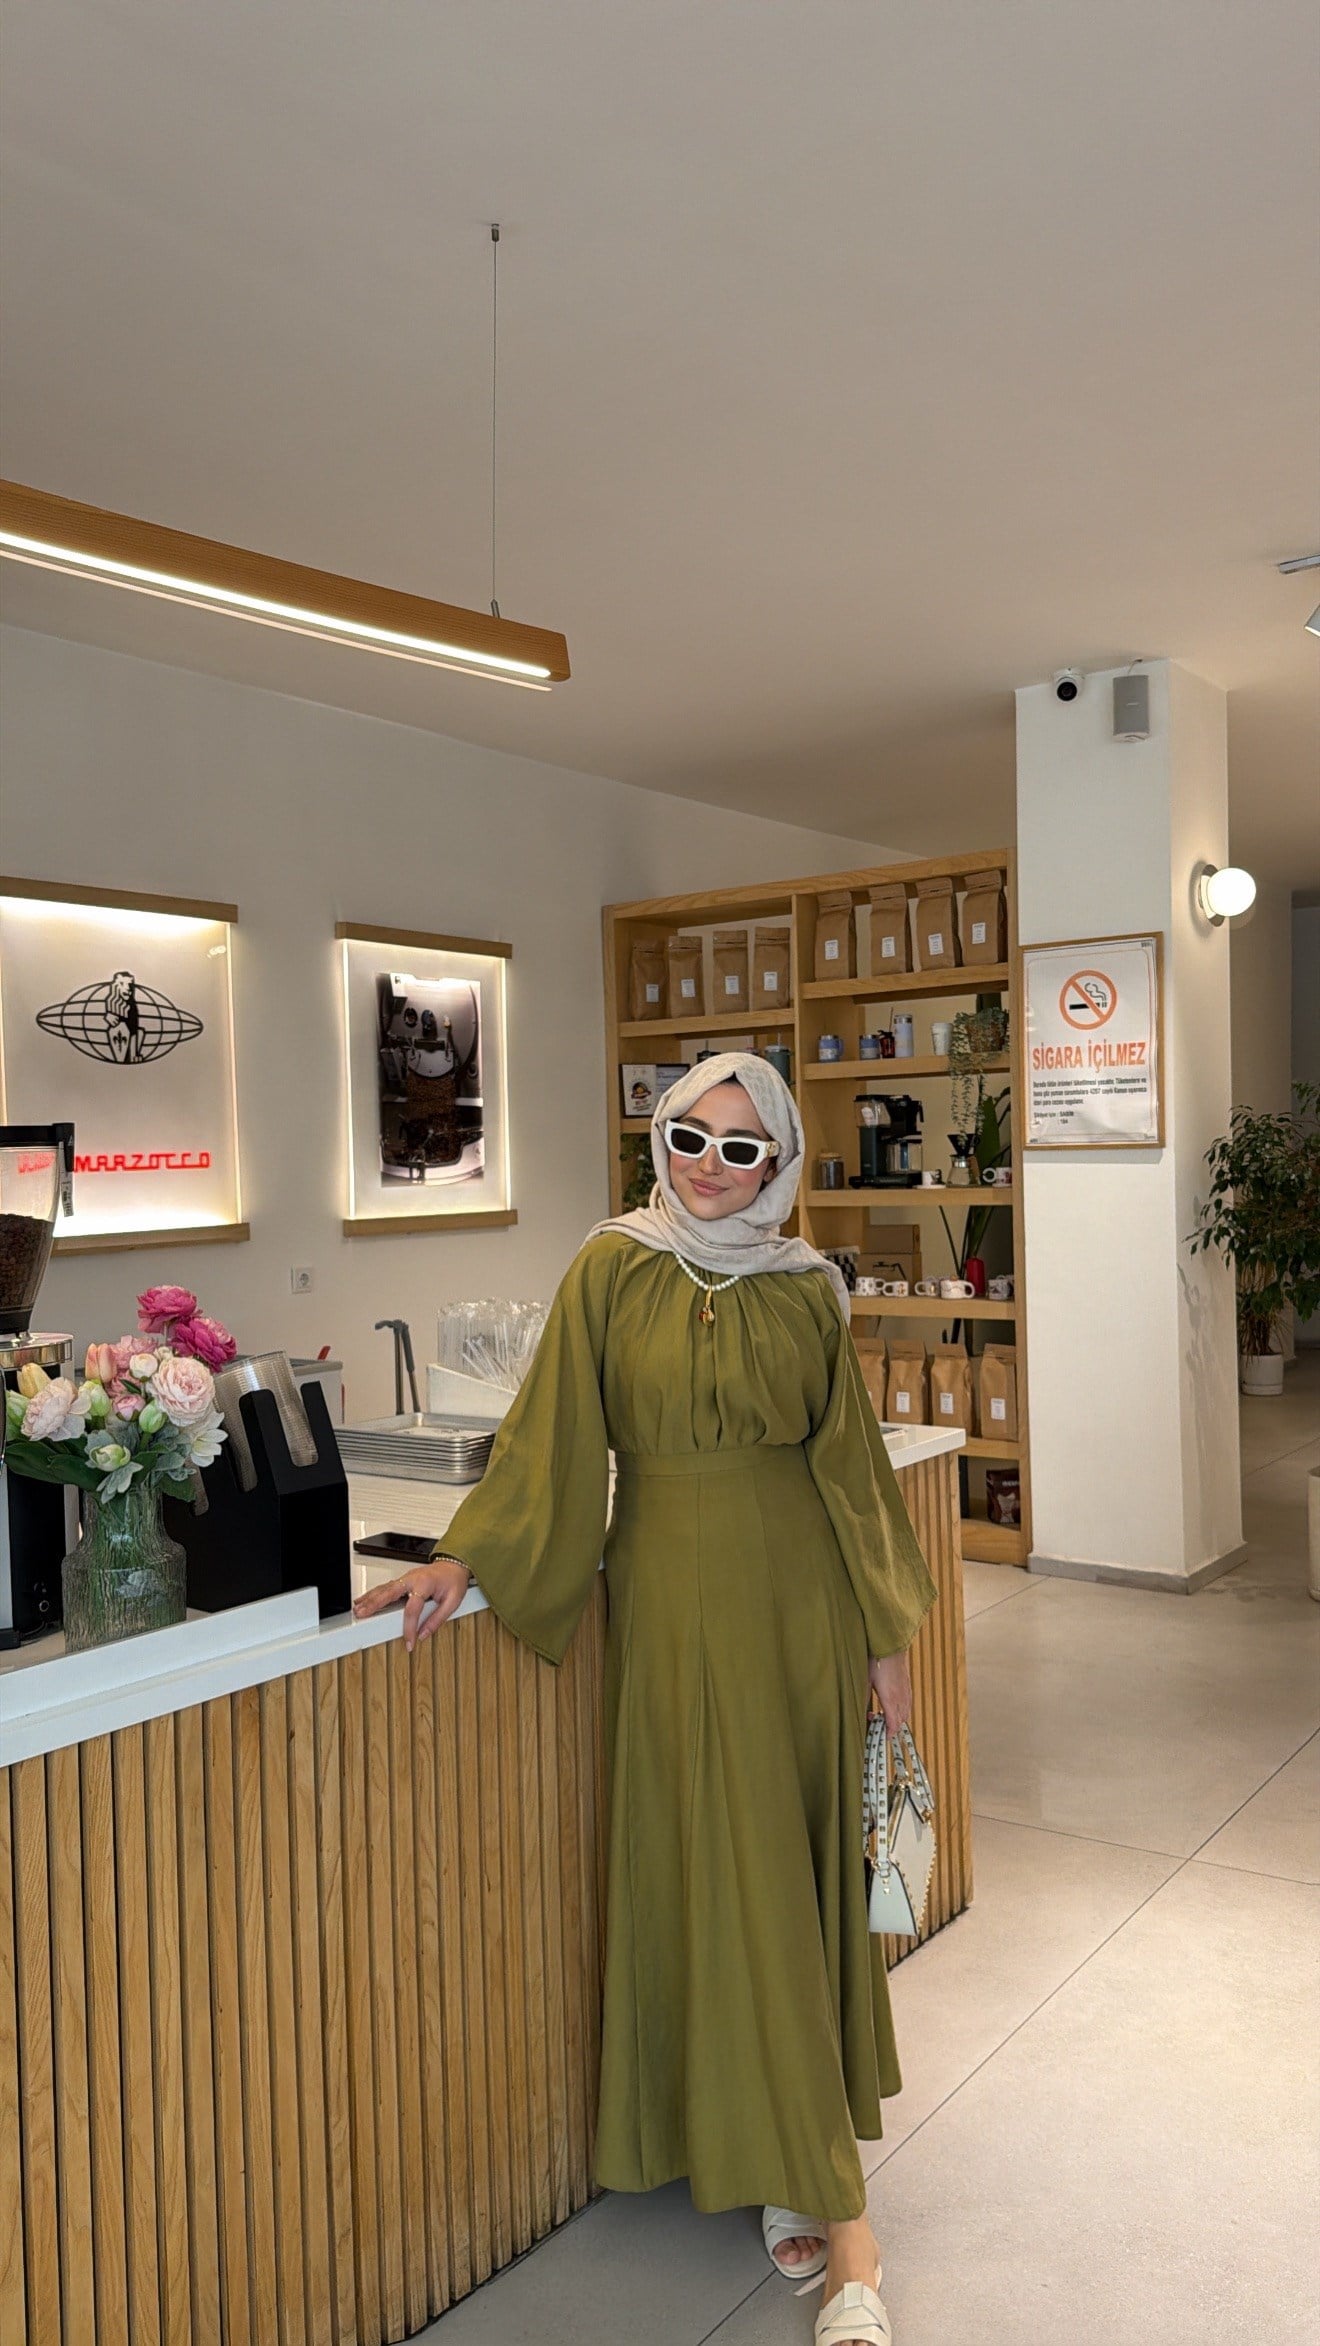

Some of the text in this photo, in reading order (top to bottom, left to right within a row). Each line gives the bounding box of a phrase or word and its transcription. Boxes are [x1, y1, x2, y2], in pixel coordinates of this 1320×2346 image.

[1032, 1039, 1146, 1073] SİGARA İÇİLMEZ
[73, 1152, 211, 1173] MARZOCCO
